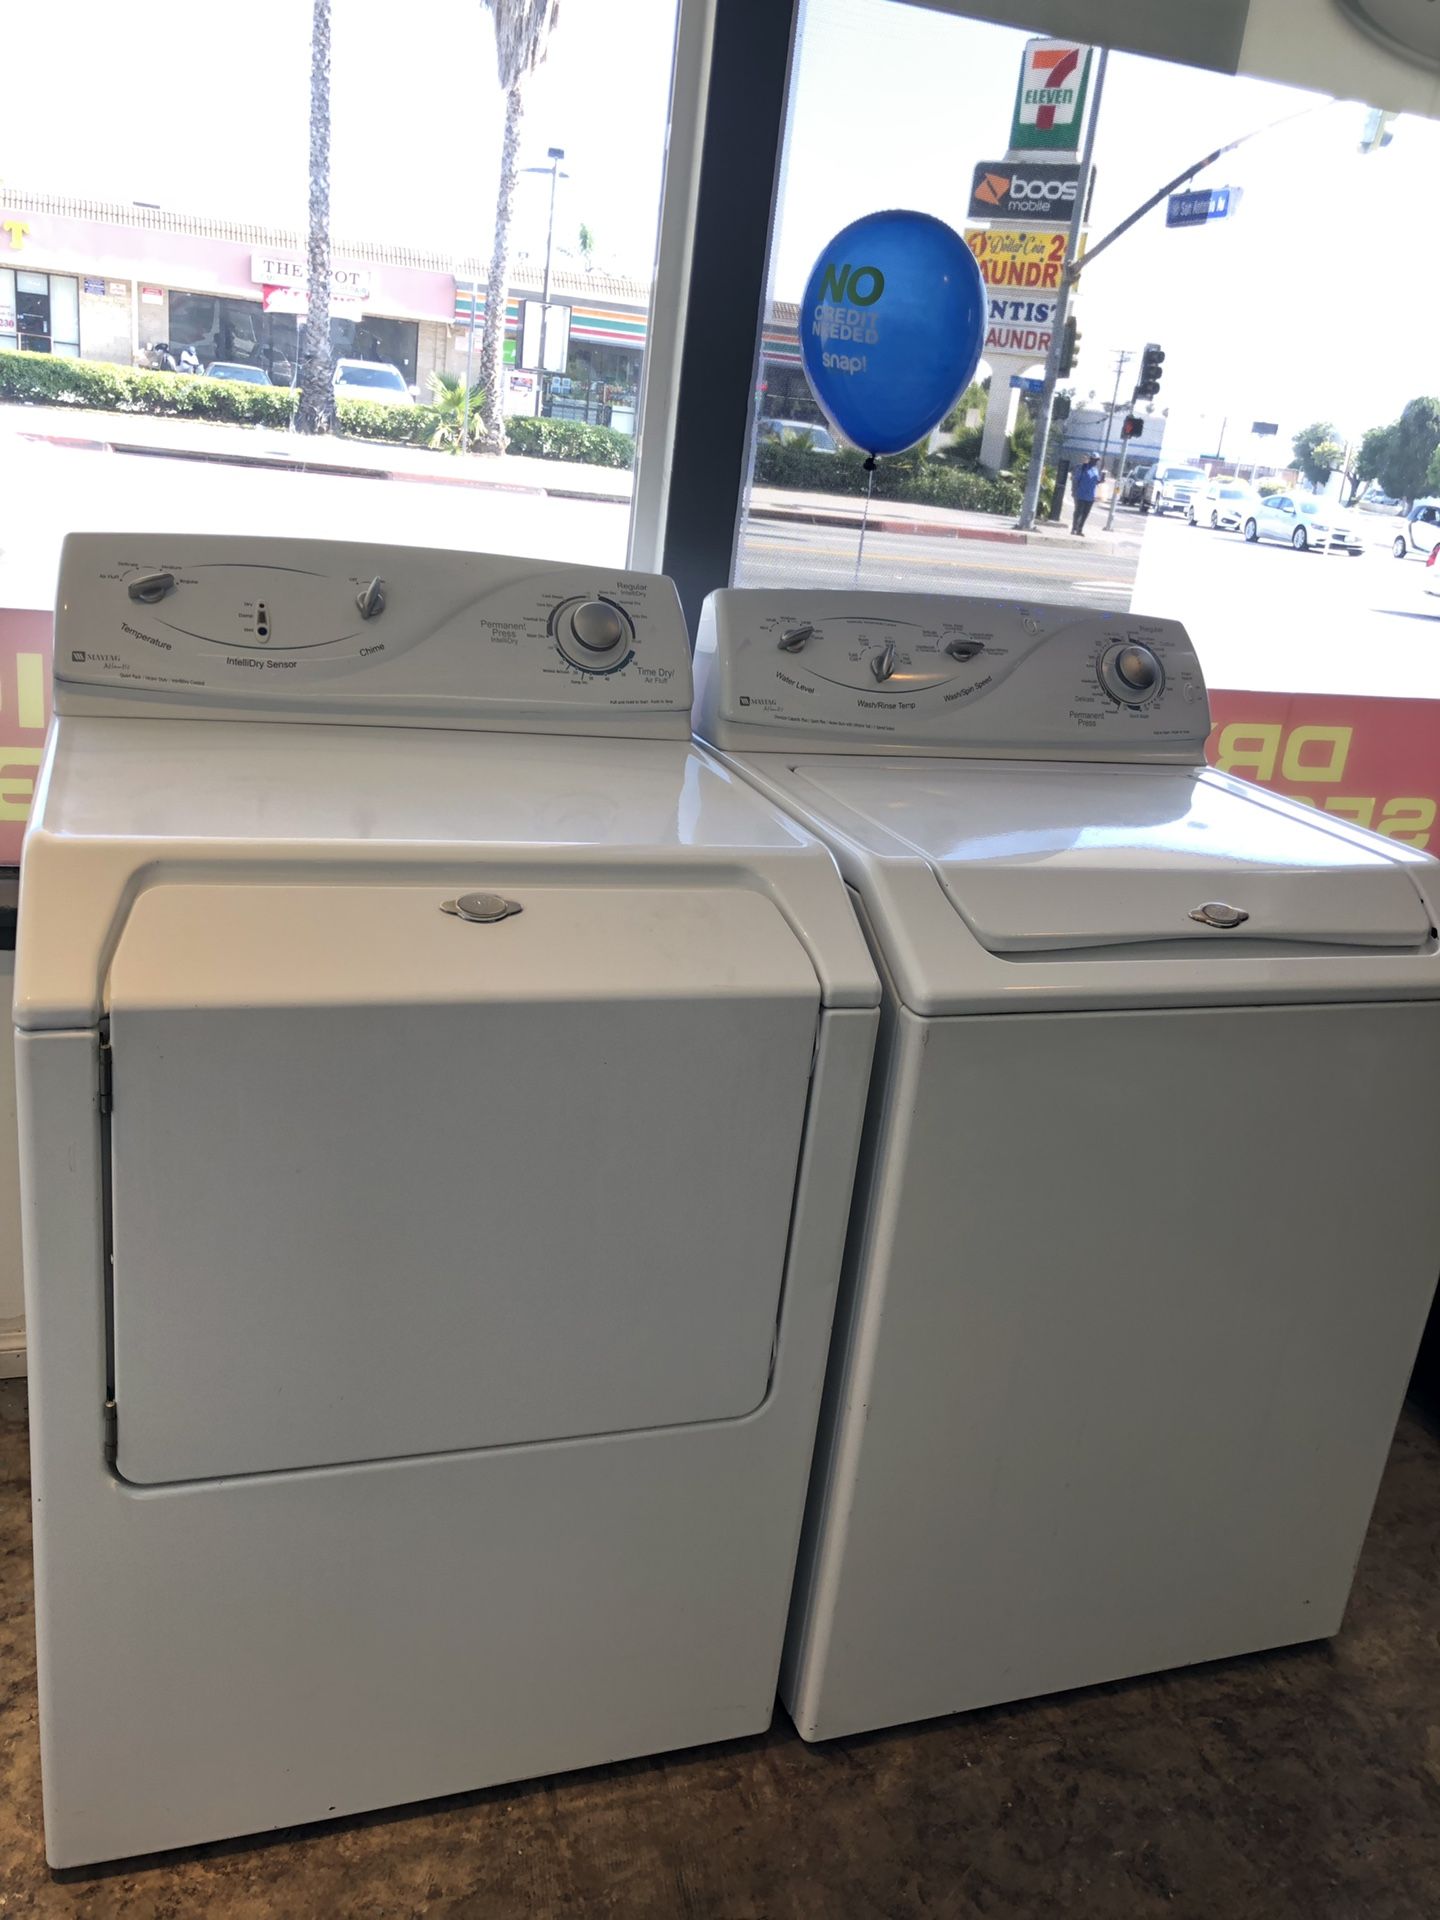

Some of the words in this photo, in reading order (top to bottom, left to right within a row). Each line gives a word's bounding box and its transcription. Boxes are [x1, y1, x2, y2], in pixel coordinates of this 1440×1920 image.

[1032, 49, 1079, 129] 7
[1009, 175, 1079, 200] boos
[1008, 201, 1051, 212] mobile
[263, 260, 303, 277] THE
[817, 264, 885, 306] NO
[814, 305, 879, 329] CREDIT
[812, 321, 879, 344] NEEDED
[822, 352, 867, 375] snap!
[617, 582, 648, 591] Regular
[480, 619, 527, 631] Permanent
[492, 628, 517, 638] Press
[120, 622, 172, 651] Temperature
[359, 643, 385, 657] Chime
[226, 657, 265, 670] IntelliDry
[266, 660, 297, 669] Sensor
[637, 667, 656, 677] Time
[776, 671, 795, 686] Water
[796, 679, 815, 694] Level
[943, 686, 975, 702] Wash/Spin
[974, 675, 993, 692] Speed
[857, 699, 897, 710] Wash/Rinse
[898, 701, 916, 711] Temp
[1069, 710, 1105, 720] Permanent
